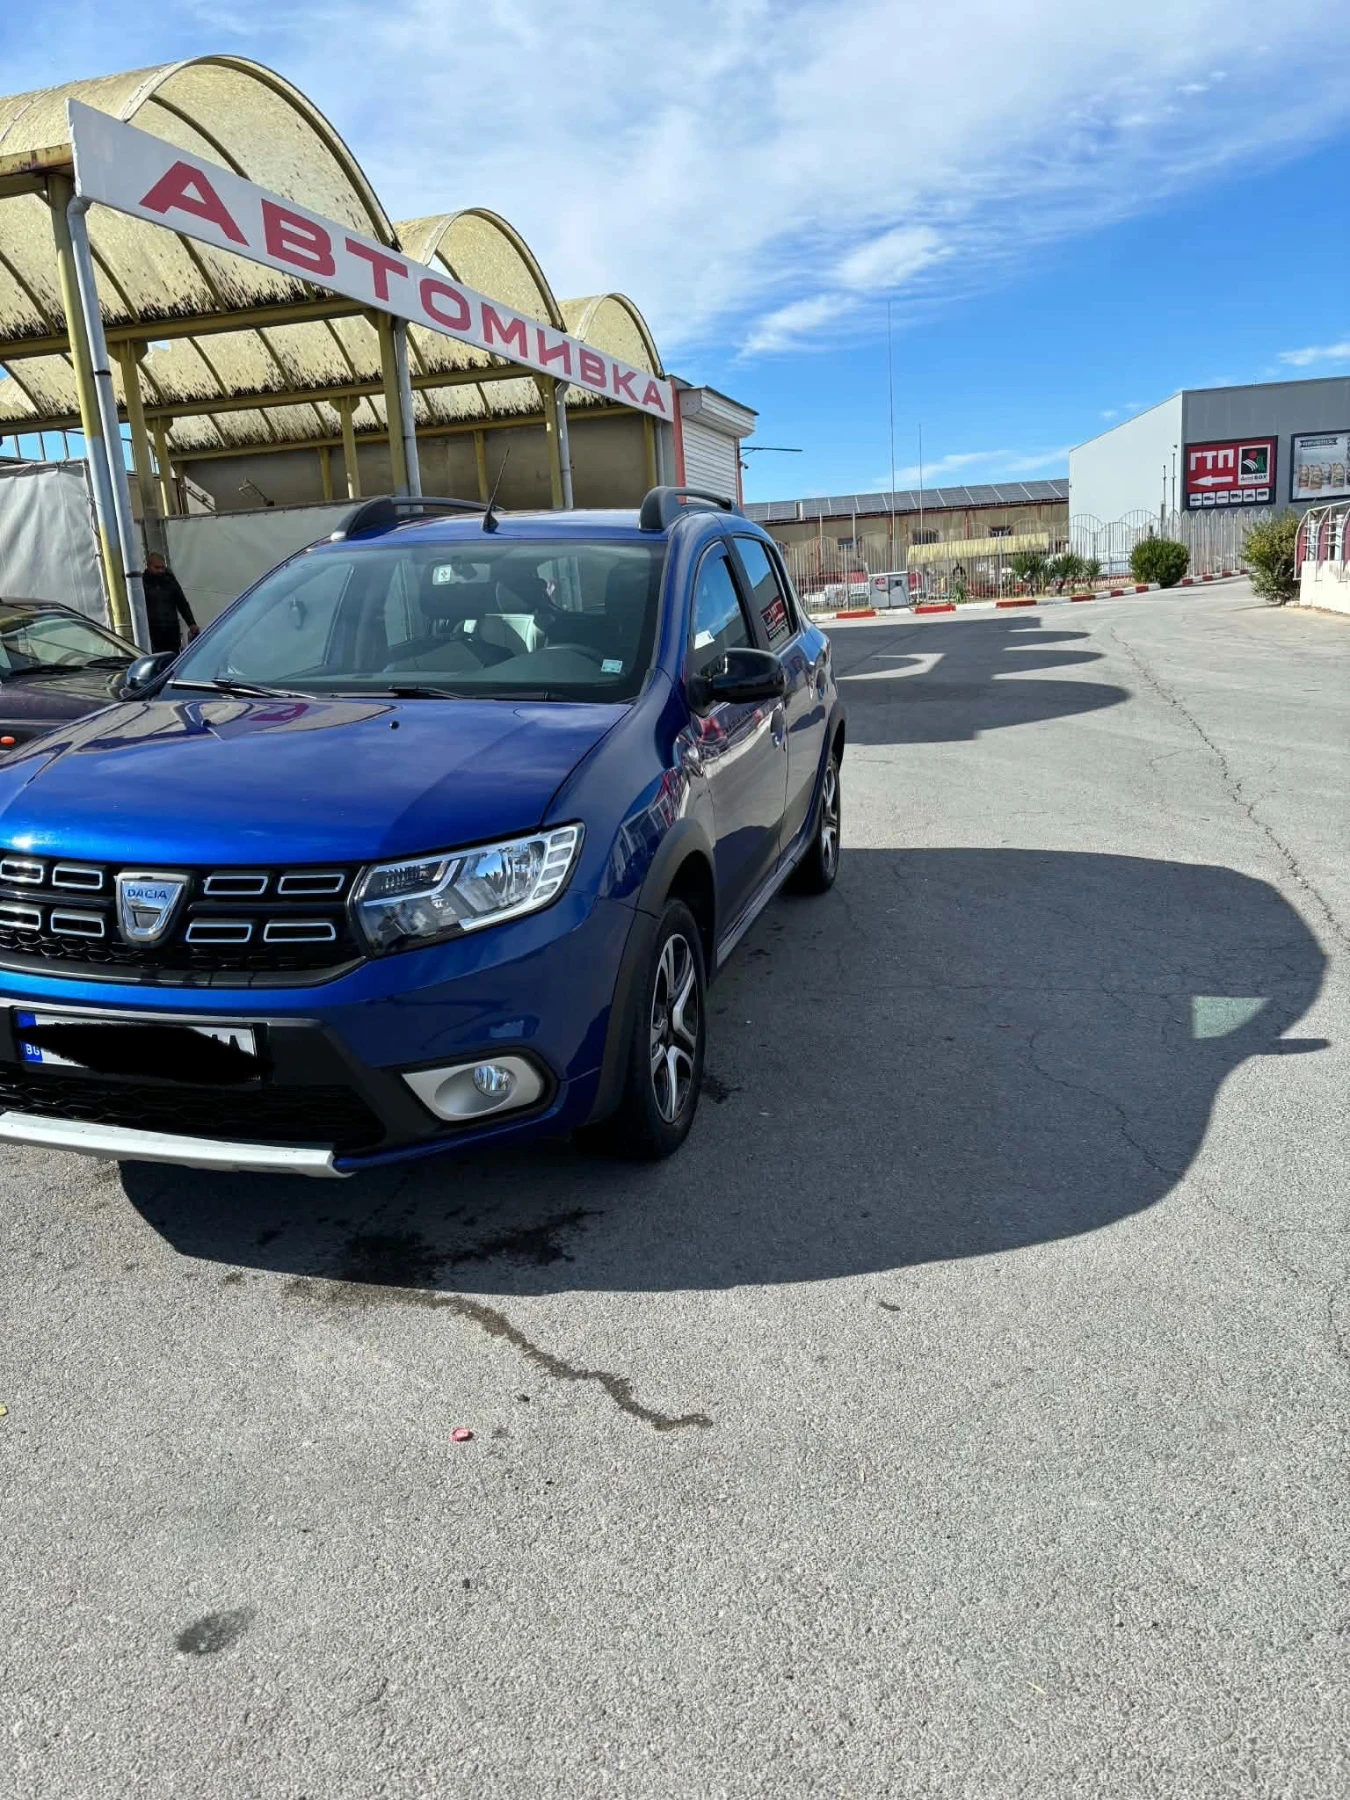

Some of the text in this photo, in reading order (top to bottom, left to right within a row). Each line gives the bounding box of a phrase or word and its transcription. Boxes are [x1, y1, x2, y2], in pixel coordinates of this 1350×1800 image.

[140, 162, 665, 413] АВТОМИВКА
[1190, 449, 1234, 471] ГТП
[127, 889, 167, 899] DACIA
